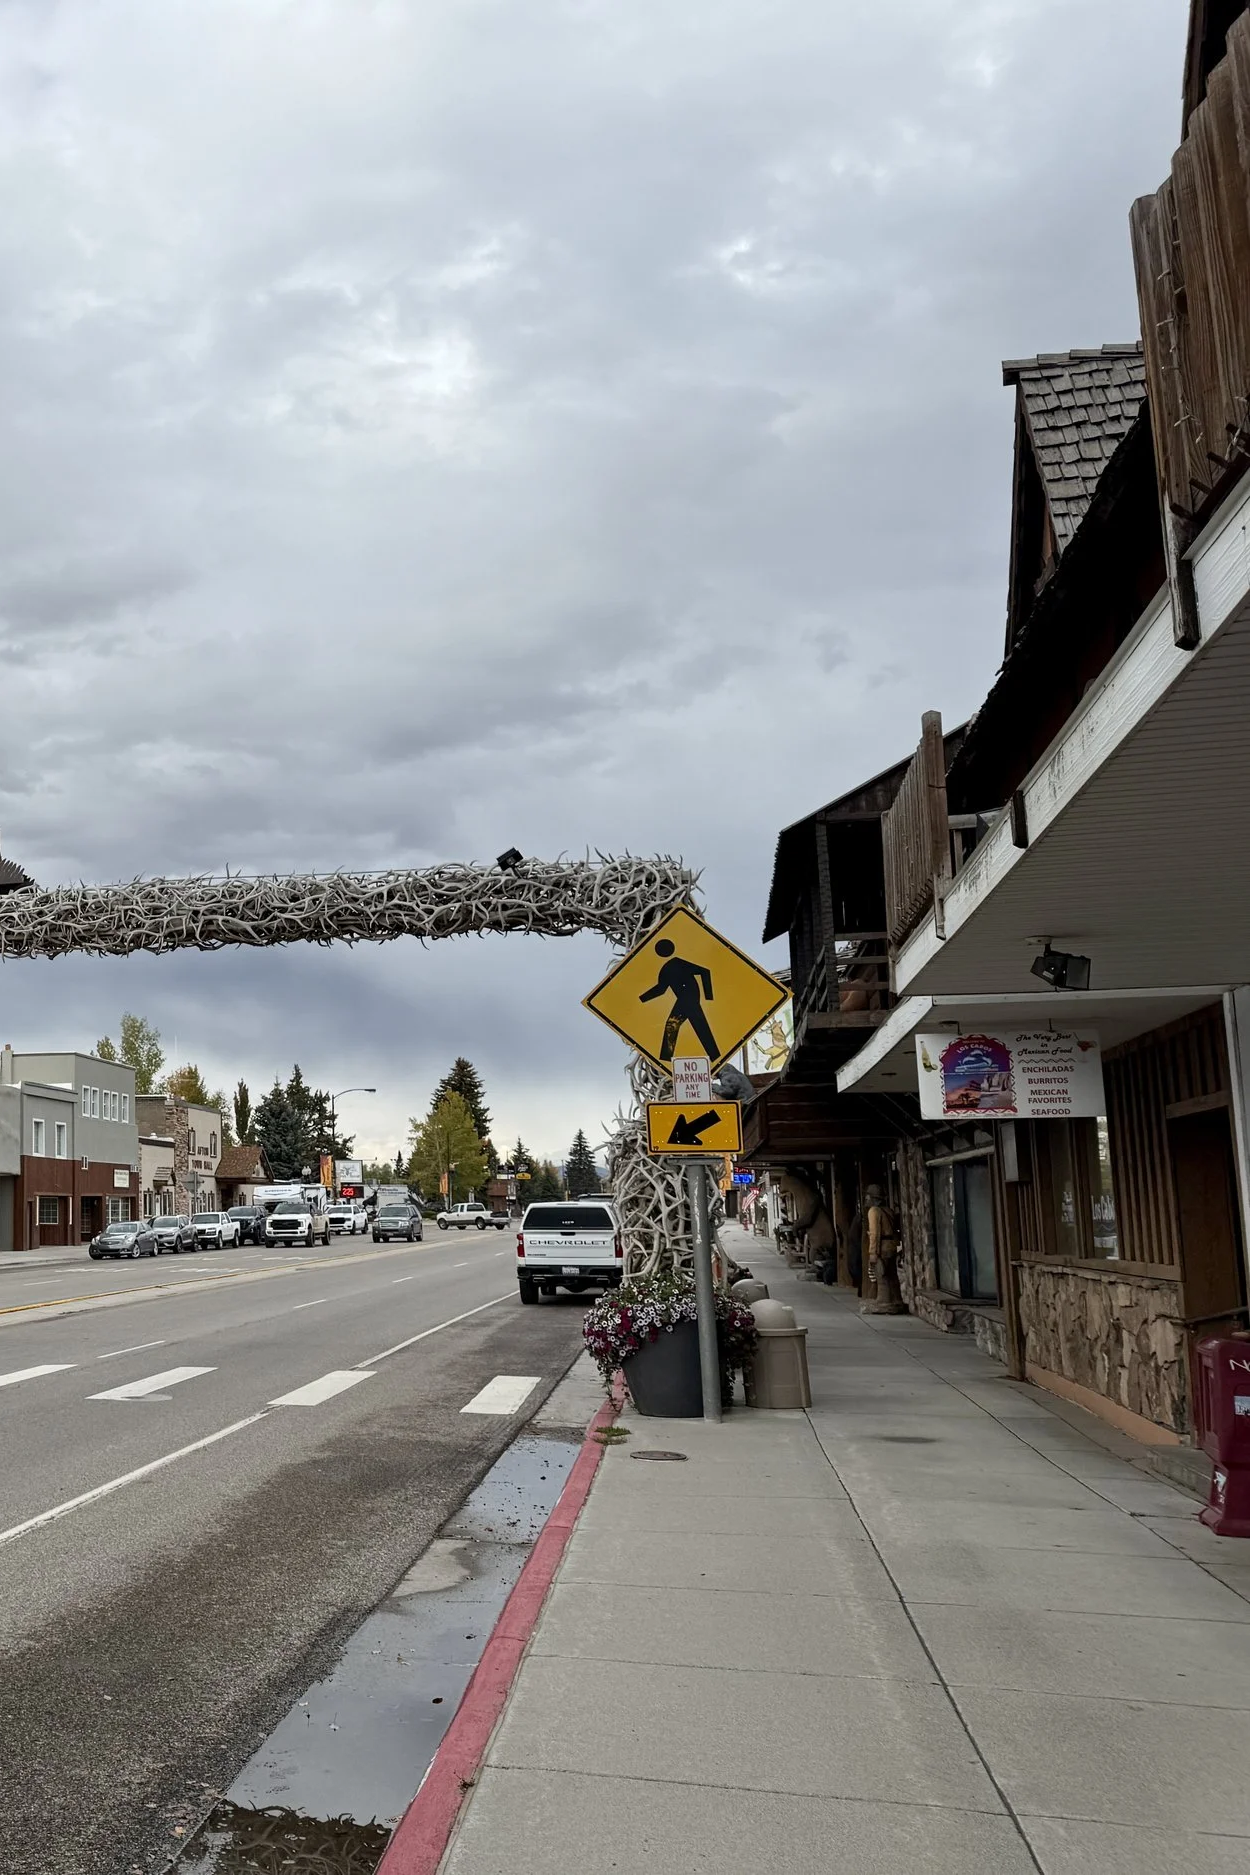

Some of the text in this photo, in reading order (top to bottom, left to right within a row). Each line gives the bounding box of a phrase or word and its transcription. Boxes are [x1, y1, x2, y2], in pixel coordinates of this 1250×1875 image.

[1015, 1033, 1072, 1042] The Very Best
[956, 1043, 992, 1054] LOS CABOS
[1017, 1046, 1073, 1056] Mexican Food
[684, 1061, 697, 1071] NO
[1022, 1065, 1074, 1073] ENCHILADAS
[675, 1073, 708, 1083] PARKING
[1028, 1077, 1069, 1085] BURRITOS
[1030, 1088, 1068, 1096] MEXICAN
[1028, 1096, 1072, 1104] FAVORITES
[1031, 1107, 1070, 1115] SEAFOOD
